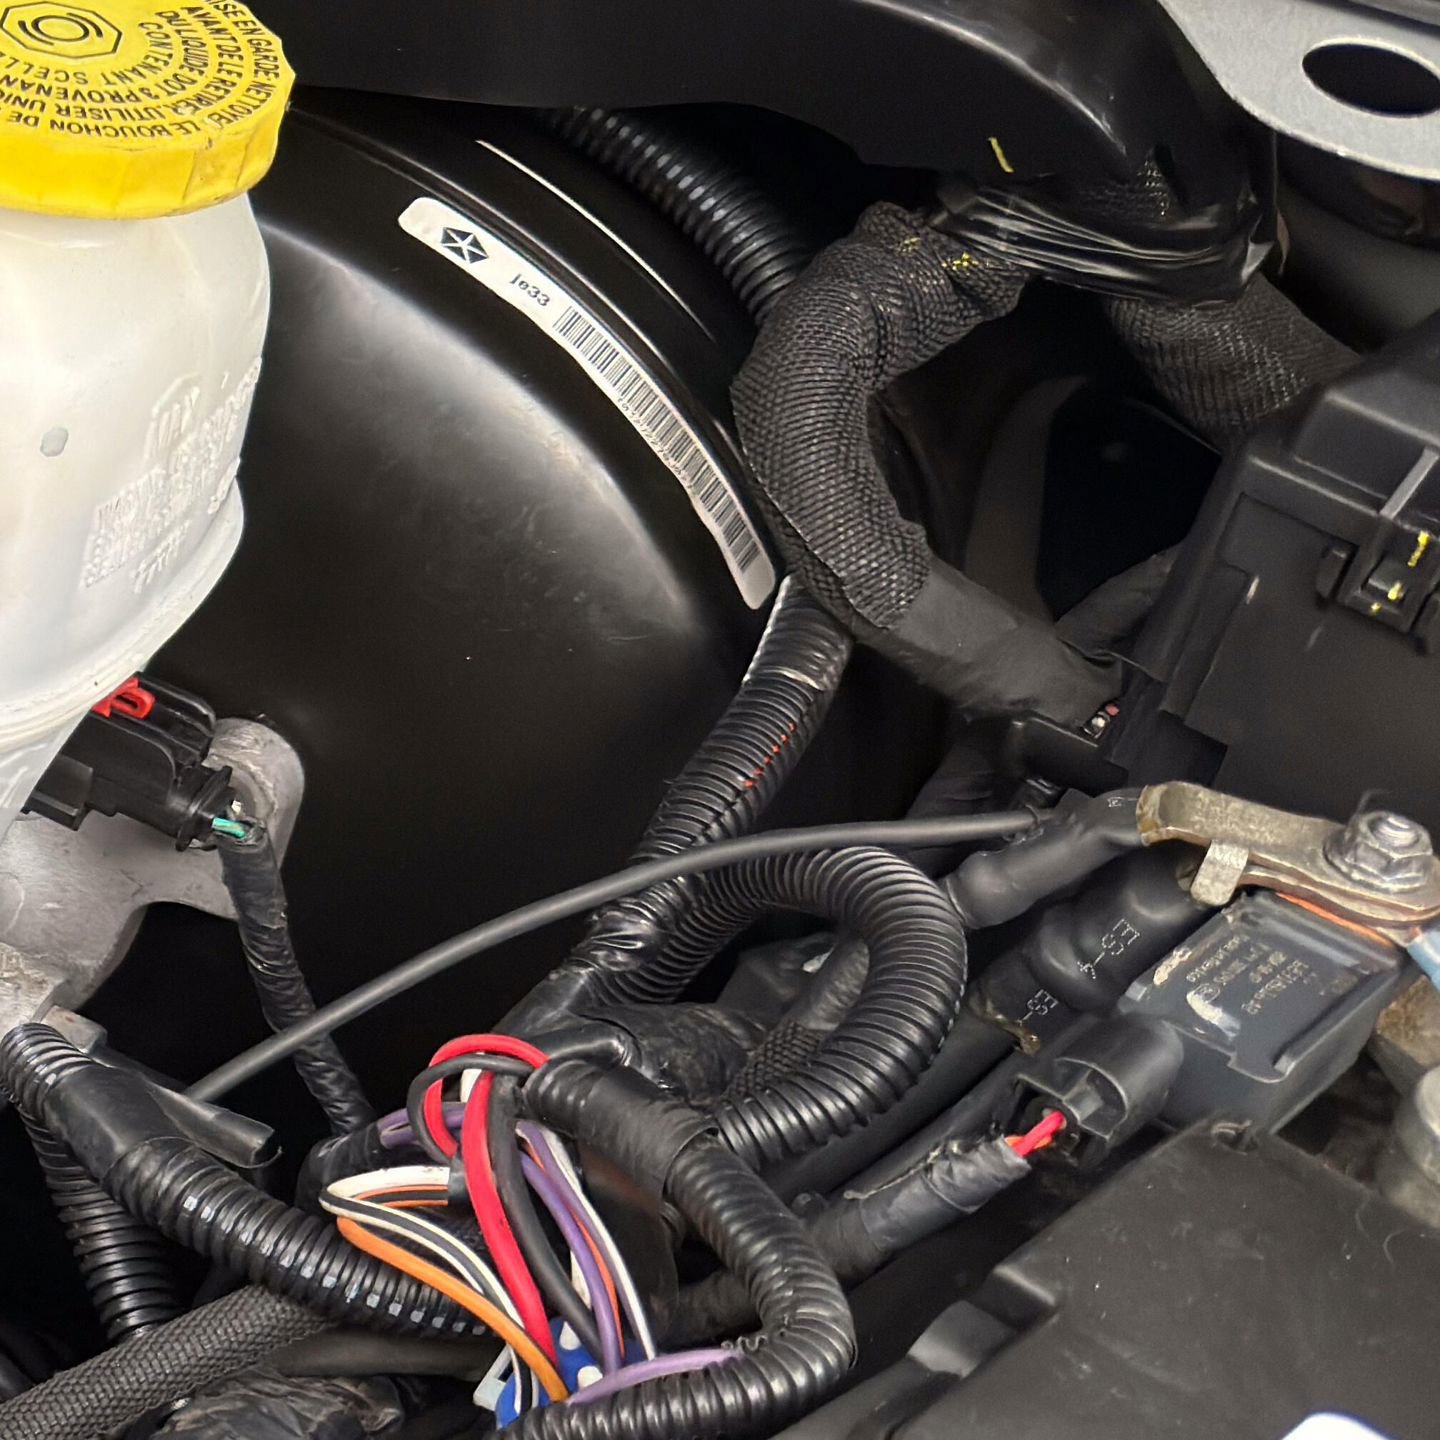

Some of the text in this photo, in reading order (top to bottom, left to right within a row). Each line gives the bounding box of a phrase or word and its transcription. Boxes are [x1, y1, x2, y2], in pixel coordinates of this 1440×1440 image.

[155, 10, 192, 27] DU
[233, 13, 265, 36] EN
[180, 6, 238, 46] AVANT
[217, 43, 243, 62] DE
[100, 22, 174, 86] CONTENANT
[176, 28, 209, 77] LIQUIDE
[154, 73, 198, 97] DOT
[8, 111, 40, 128] DE
[49, 117, 170, 138] BOUCHON
[169, 119, 200, 136] LE
